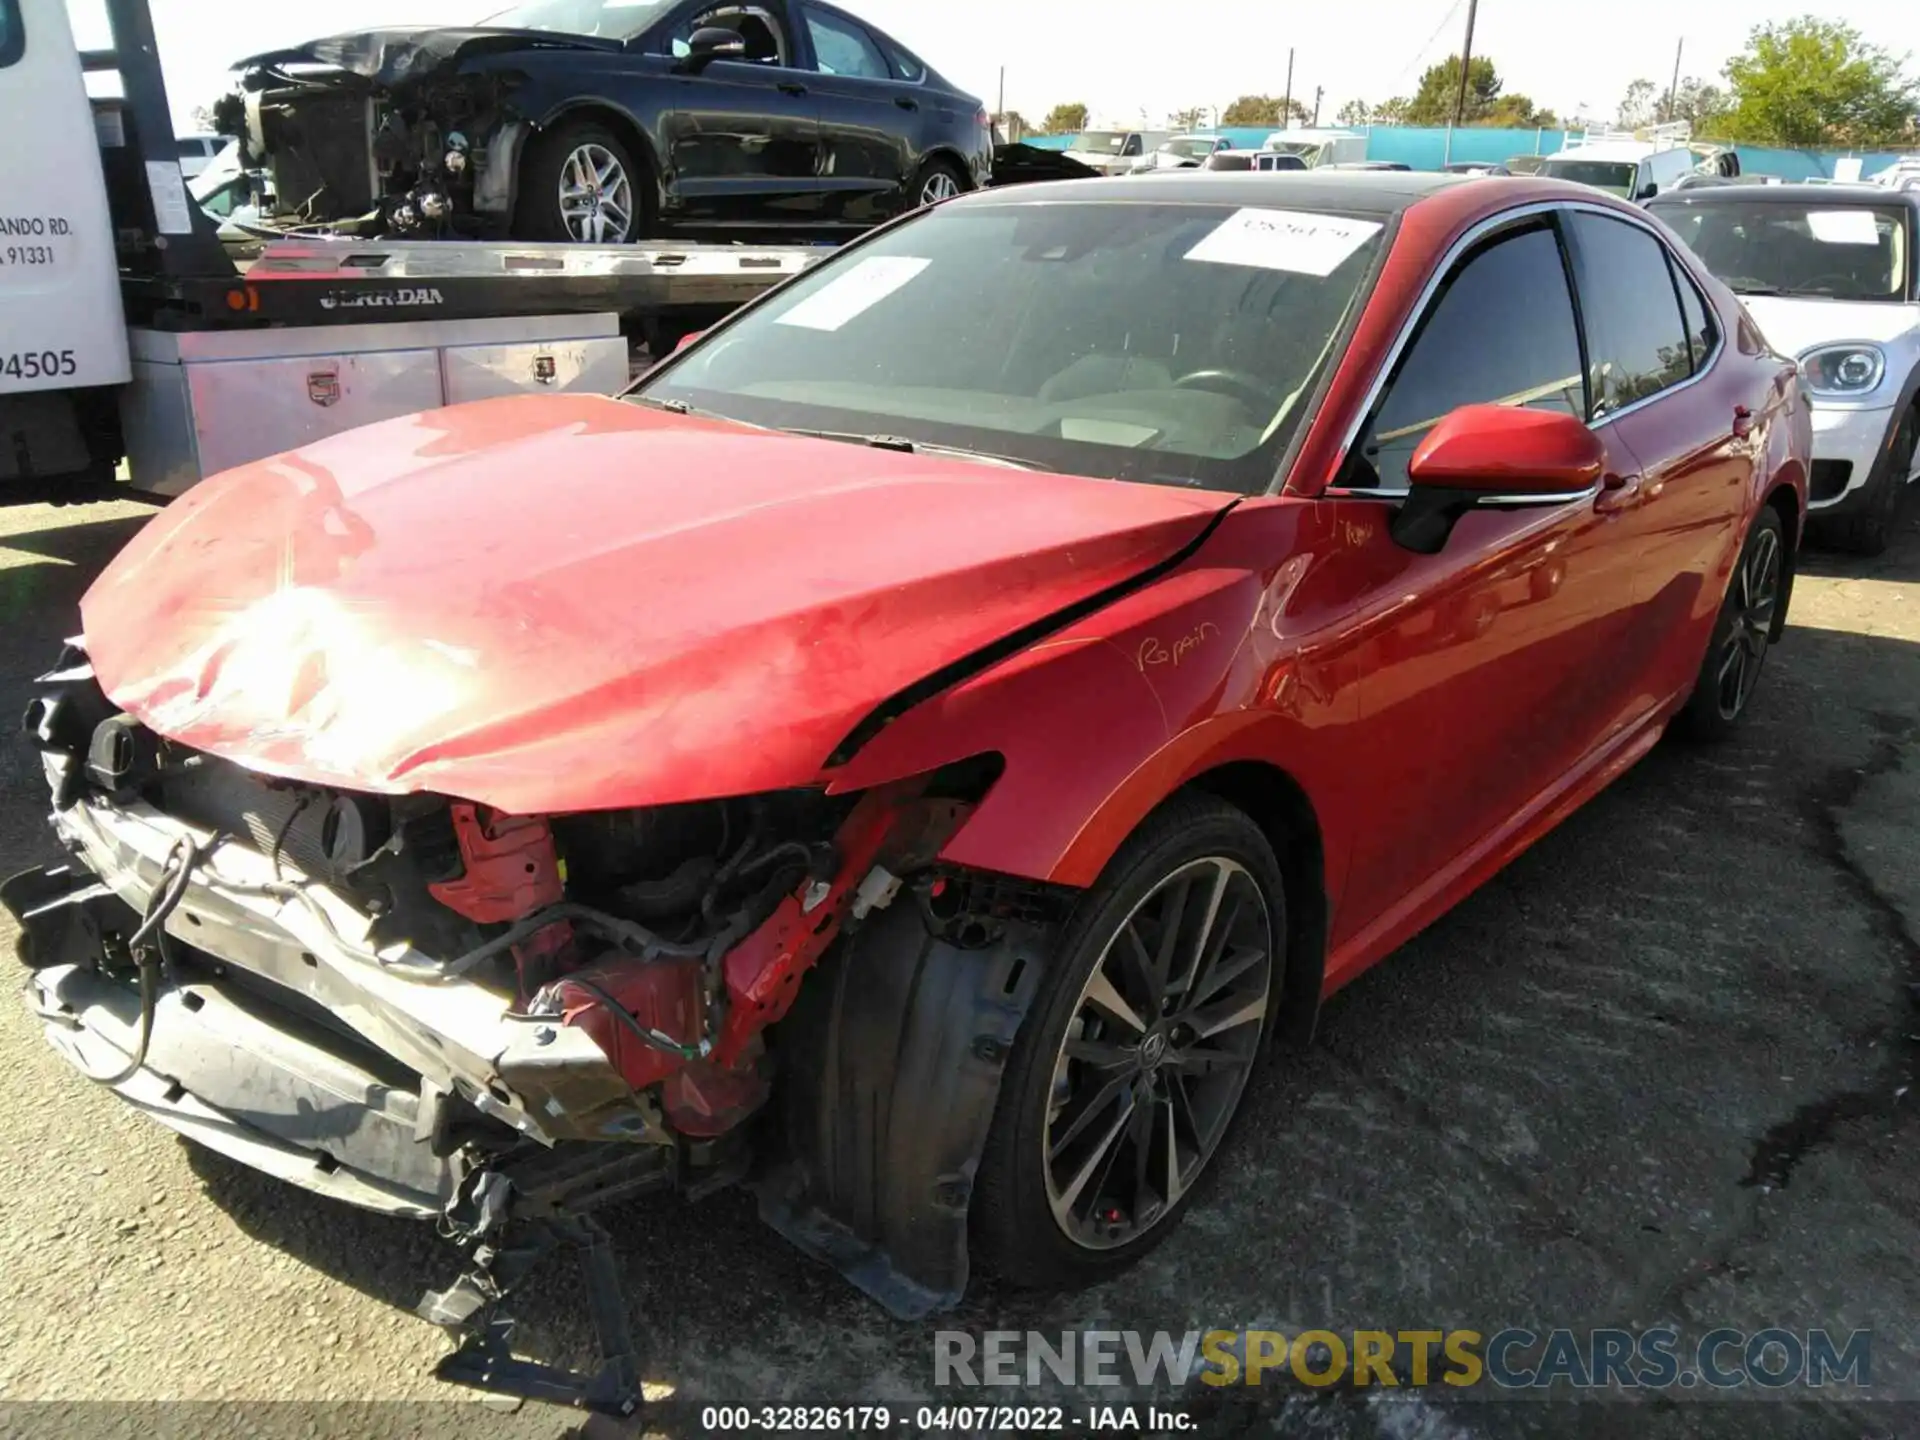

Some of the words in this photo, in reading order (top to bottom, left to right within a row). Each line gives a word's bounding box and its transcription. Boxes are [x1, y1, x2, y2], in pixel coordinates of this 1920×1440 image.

[48, 217, 73, 235] RD.
[7, 246, 54, 264] 91331
[0, 350, 76, 379] 4505
